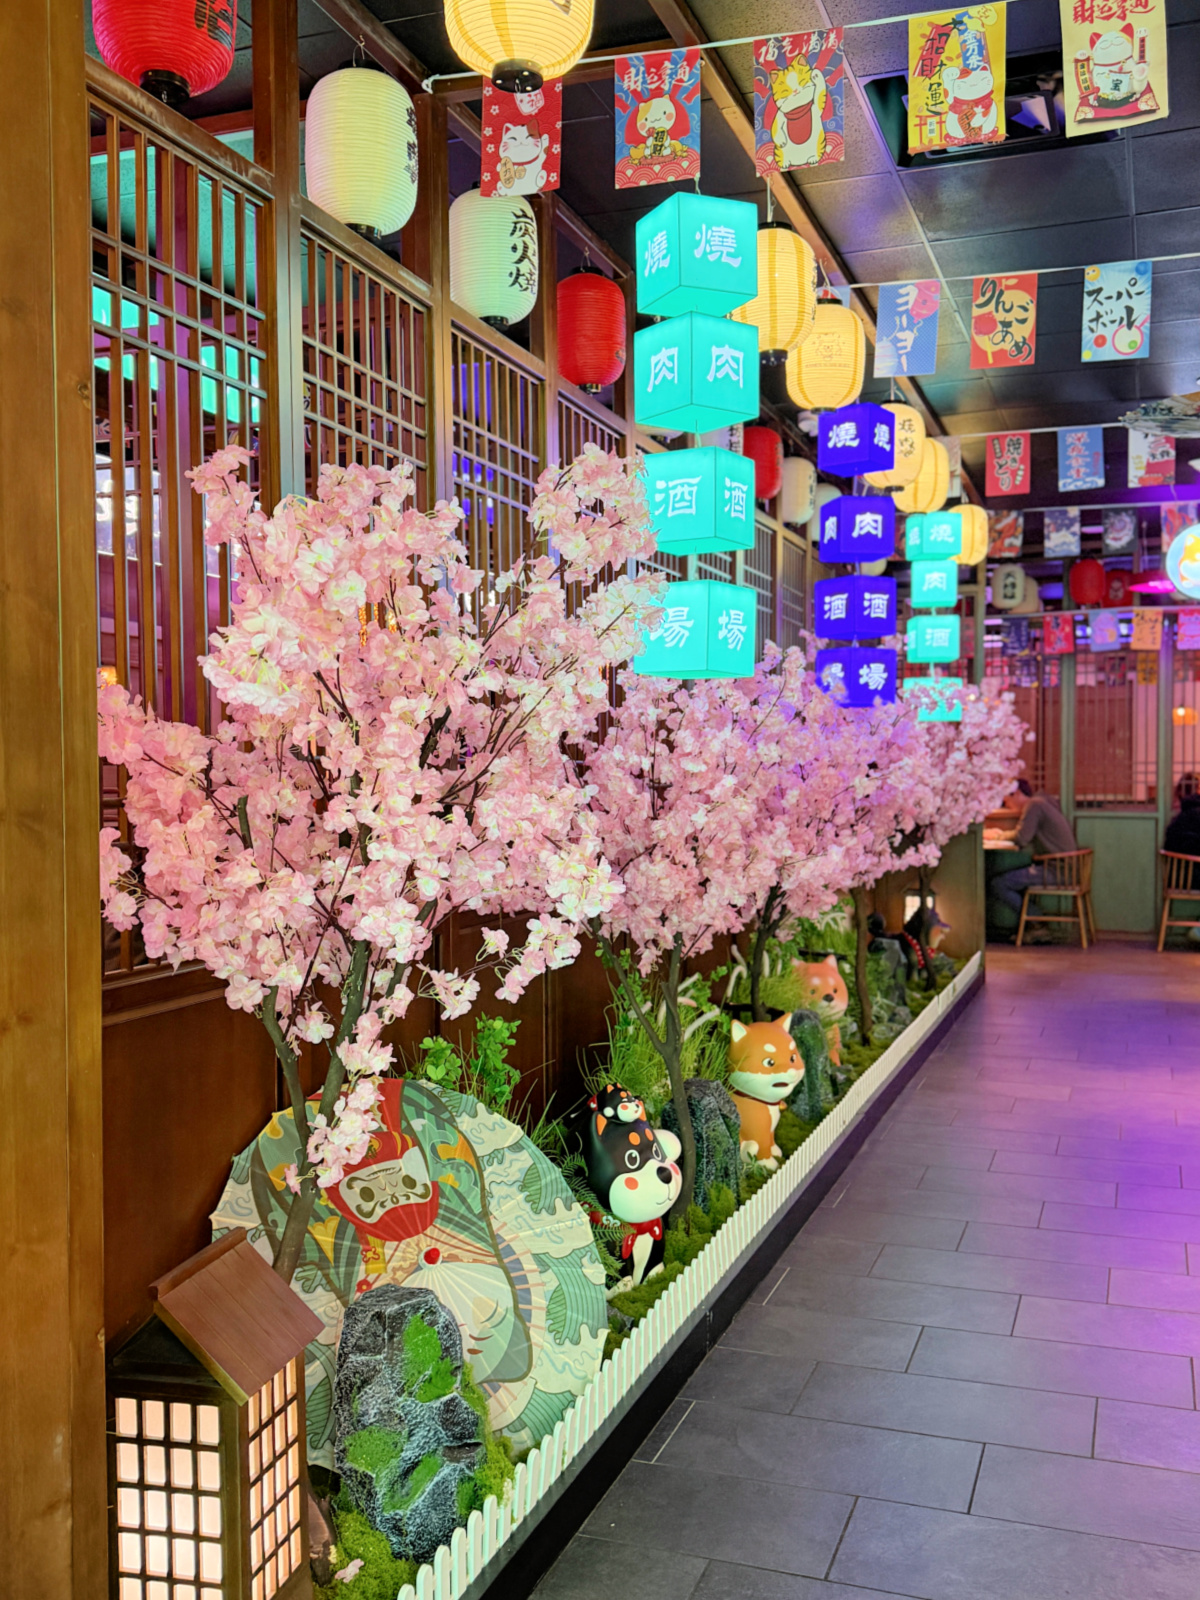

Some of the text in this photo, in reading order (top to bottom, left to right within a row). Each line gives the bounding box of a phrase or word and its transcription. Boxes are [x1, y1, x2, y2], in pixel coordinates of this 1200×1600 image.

[975, 277, 1034, 326] りんご
[1084, 277, 1146, 311] スーパー
[896, 285, 919, 373] ヨーヨー
[991, 317, 1033, 362] あめ
[1088, 305, 1142, 334] ボール
[646, 346, 679, 392] 肉
[706, 344, 744, 389] 肉
[654, 475, 702, 518] 酒
[725, 476, 748, 521] 酒
[852, 511, 883, 539] 肉
[923, 571, 947, 591] 肉
[823, 592, 848, 620] 酒
[863, 591, 890, 619] 酒
[718, 609, 748, 651] 場
